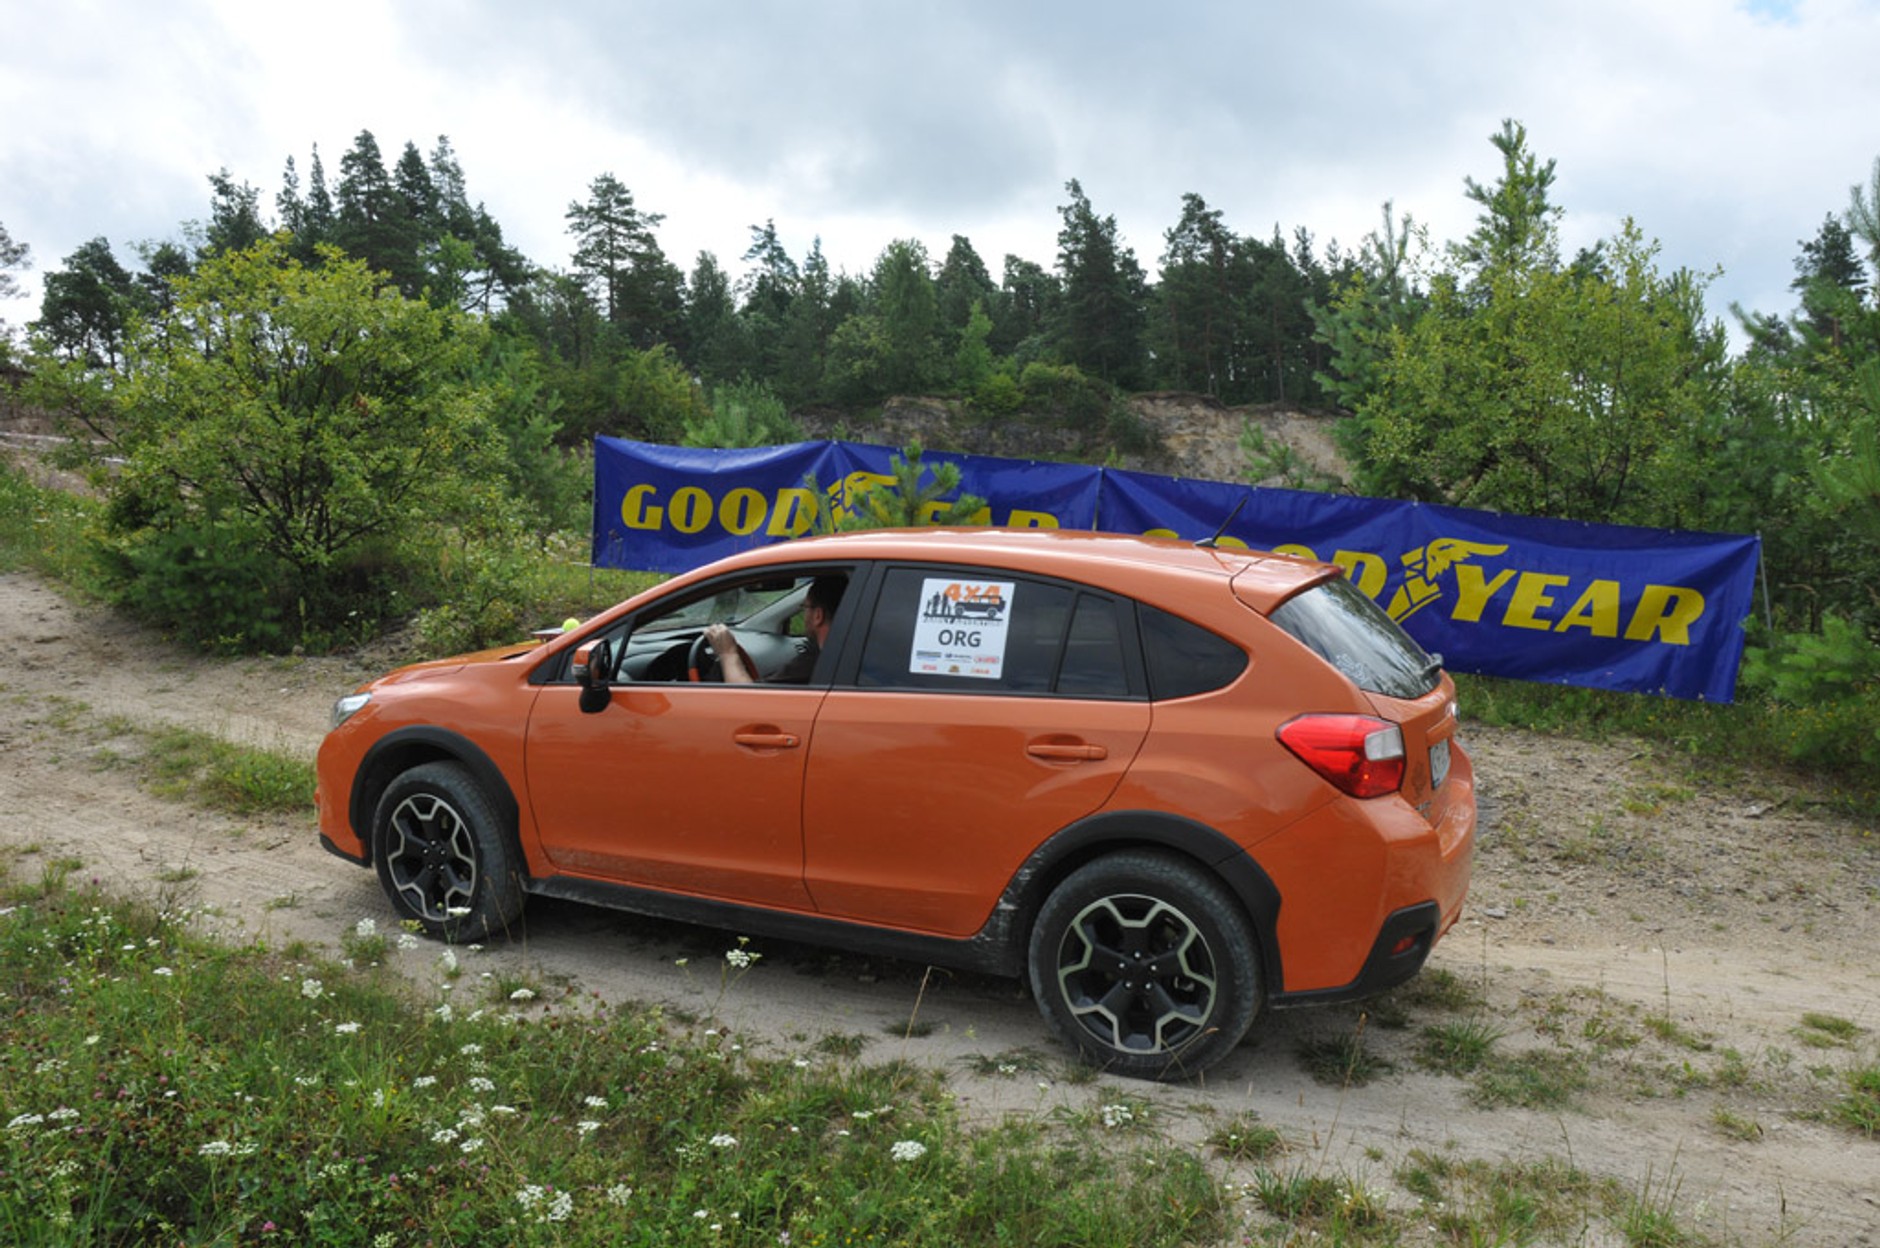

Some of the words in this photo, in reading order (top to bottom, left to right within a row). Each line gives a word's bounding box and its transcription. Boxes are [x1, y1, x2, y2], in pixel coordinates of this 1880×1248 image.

[621, 484, 819, 536] GOOD
[1450, 563, 1705, 646] YEAR
[938, 629, 982, 648] ORG
